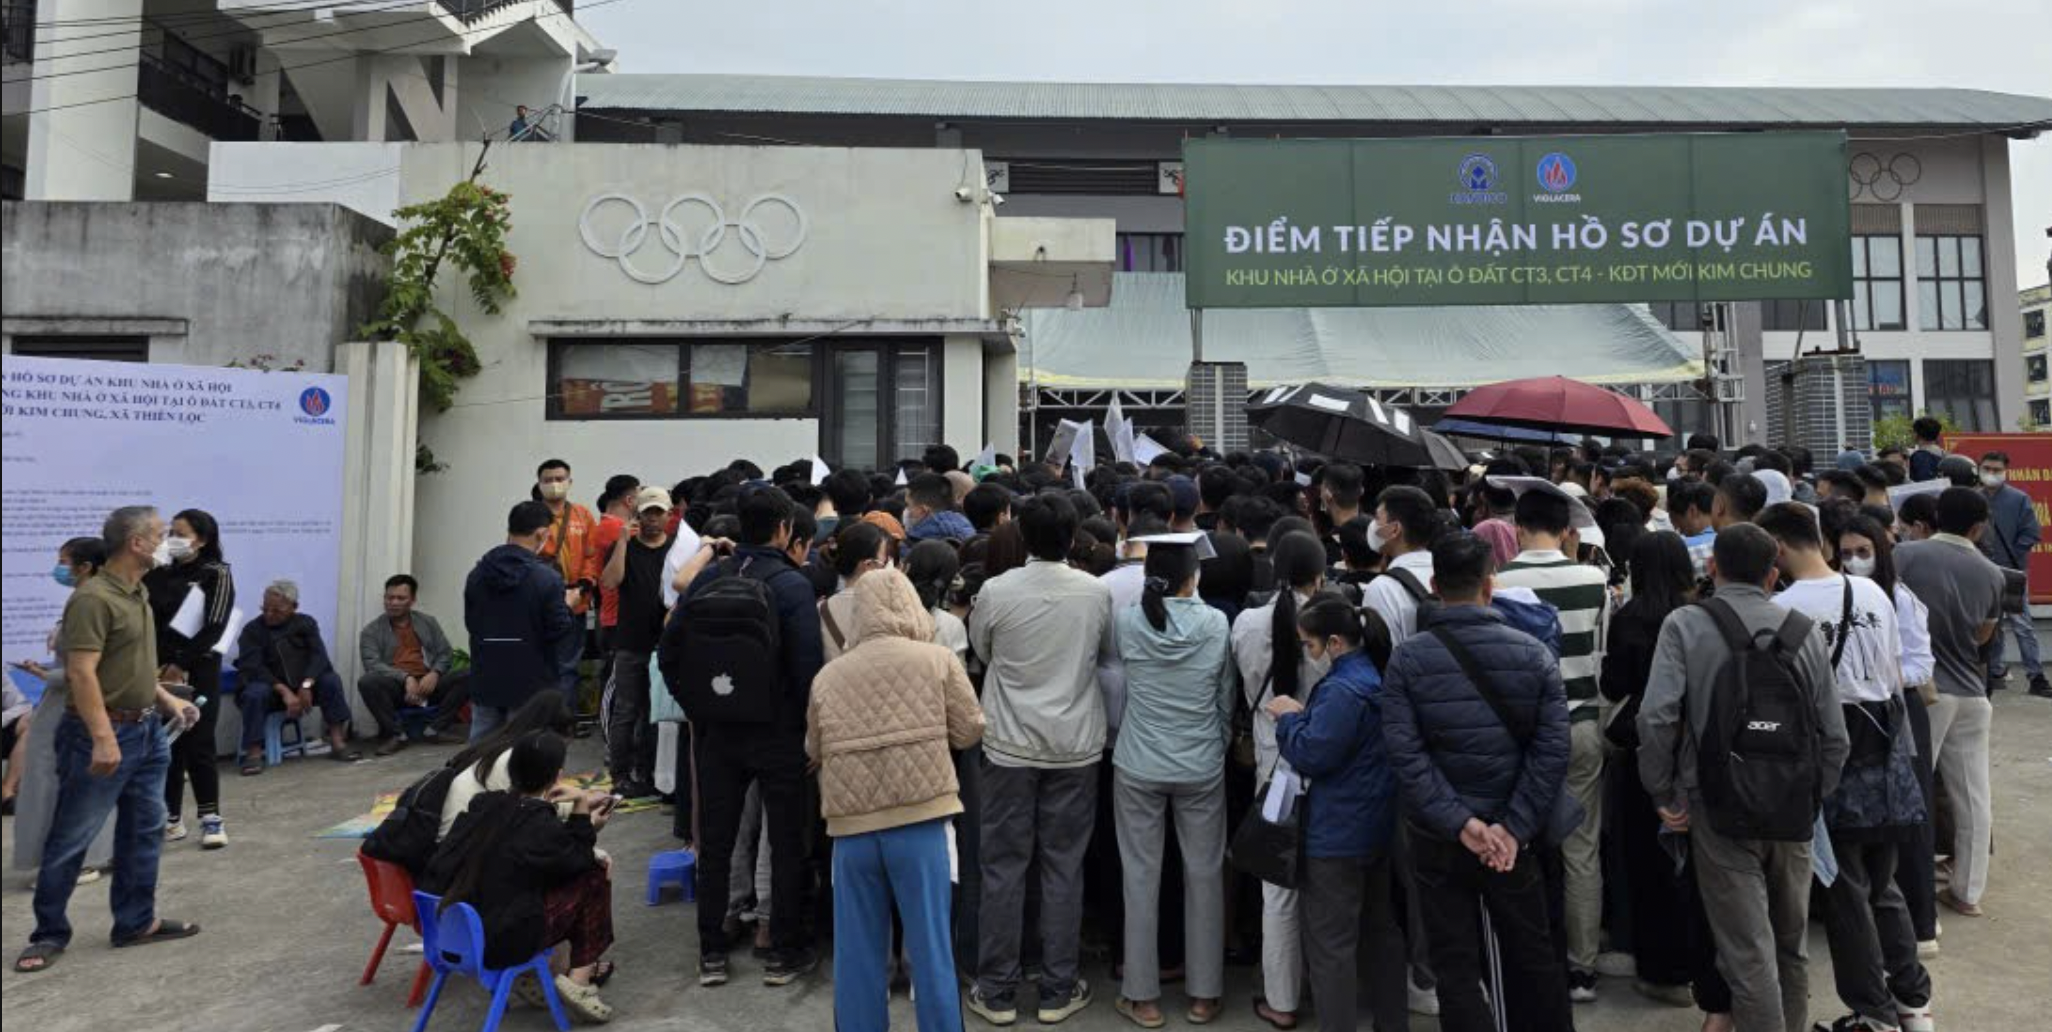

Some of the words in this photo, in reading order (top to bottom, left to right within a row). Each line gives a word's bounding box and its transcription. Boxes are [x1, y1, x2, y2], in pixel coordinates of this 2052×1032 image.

[1533, 194, 1582, 203] VIGLACERA
[1224, 216, 1321, 253] ĐIỂM
[1333, 216, 1414, 252] TIẾP
[1427, 218, 1538, 257] NHẬN
[1552, 214, 1608, 249] HỒ
[1621, 218, 1673, 249] SƠ
[1687, 216, 1745, 253] DỰ
[1754, 212, 1808, 246] ÁN
[1226, 269, 1269, 286] KHU
[1275, 265, 1318, 286] NHÀ
[1322, 266, 1339, 286] Ở
[1343, 265, 1370, 285] XÃ
[1375, 266, 1410, 288] HỘI
[1414, 268, 1442, 288] TẠI
[1447, 264, 1464, 285] Ô
[1468, 264, 1508, 284] ĐẤT
[1511, 267, 1552, 285] CT3,
[1556, 266, 1592, 283] CT4
[1610, 265, 1649, 282] KĐT
[1653, 261, 1692, 281] MỚI
[1698, 263, 1735, 280] KIM
[1740, 261, 1813, 280] CHUNG
[107, 377, 137, 388] KHU
[26, 389, 57, 401] KHU
[18, 406, 48, 417] KIM
[1747, 720, 1782, 731] acer
